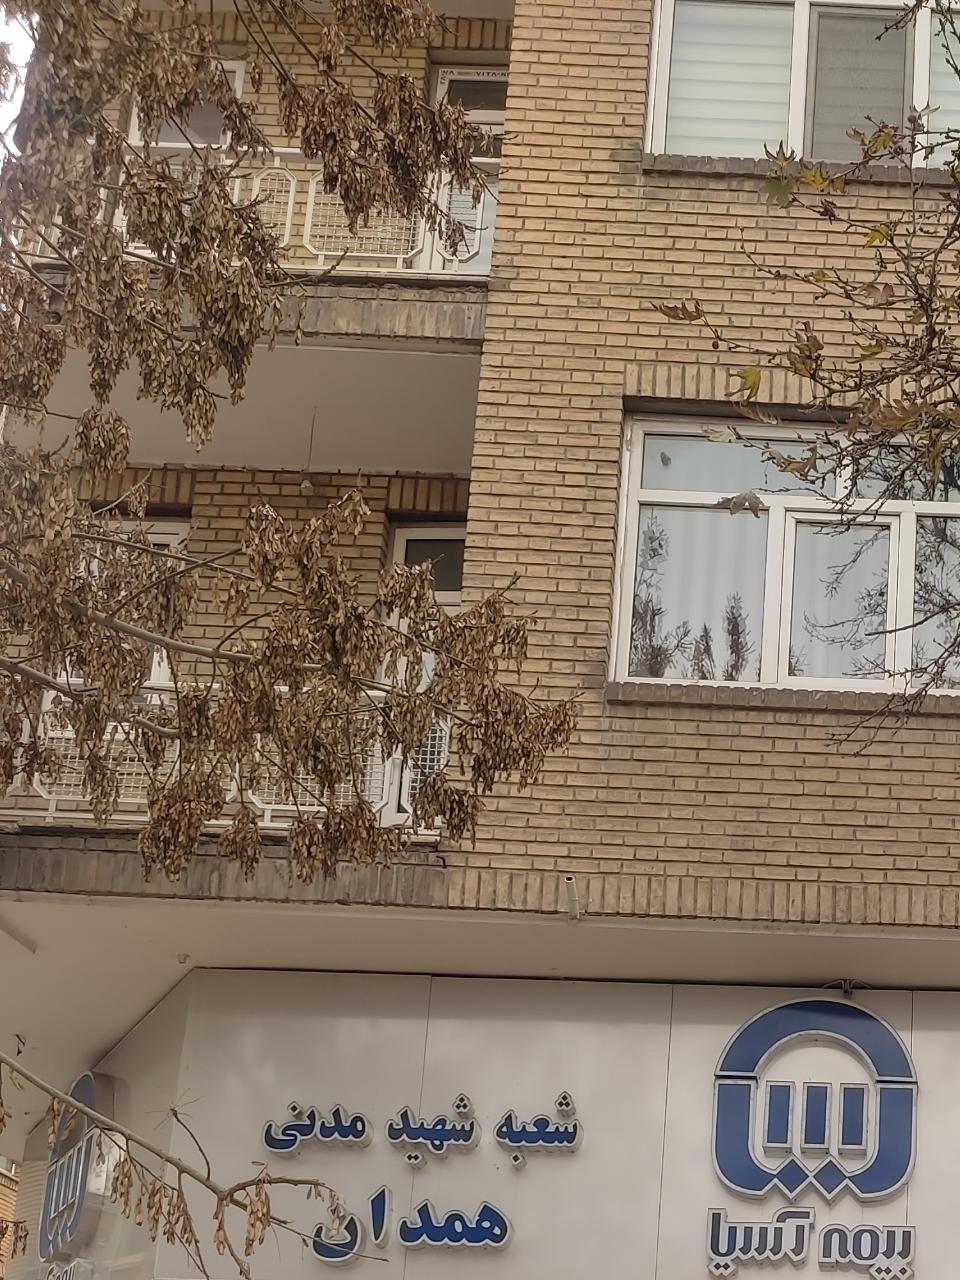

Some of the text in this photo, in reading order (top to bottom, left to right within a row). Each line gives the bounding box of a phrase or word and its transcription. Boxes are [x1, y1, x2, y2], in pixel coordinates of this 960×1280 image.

[262, 1091, 584, 1171] شعبه شهید مدنی
[311, 1184, 514, 1267] همدان
[707, 1206, 816, 1280] آسیا
